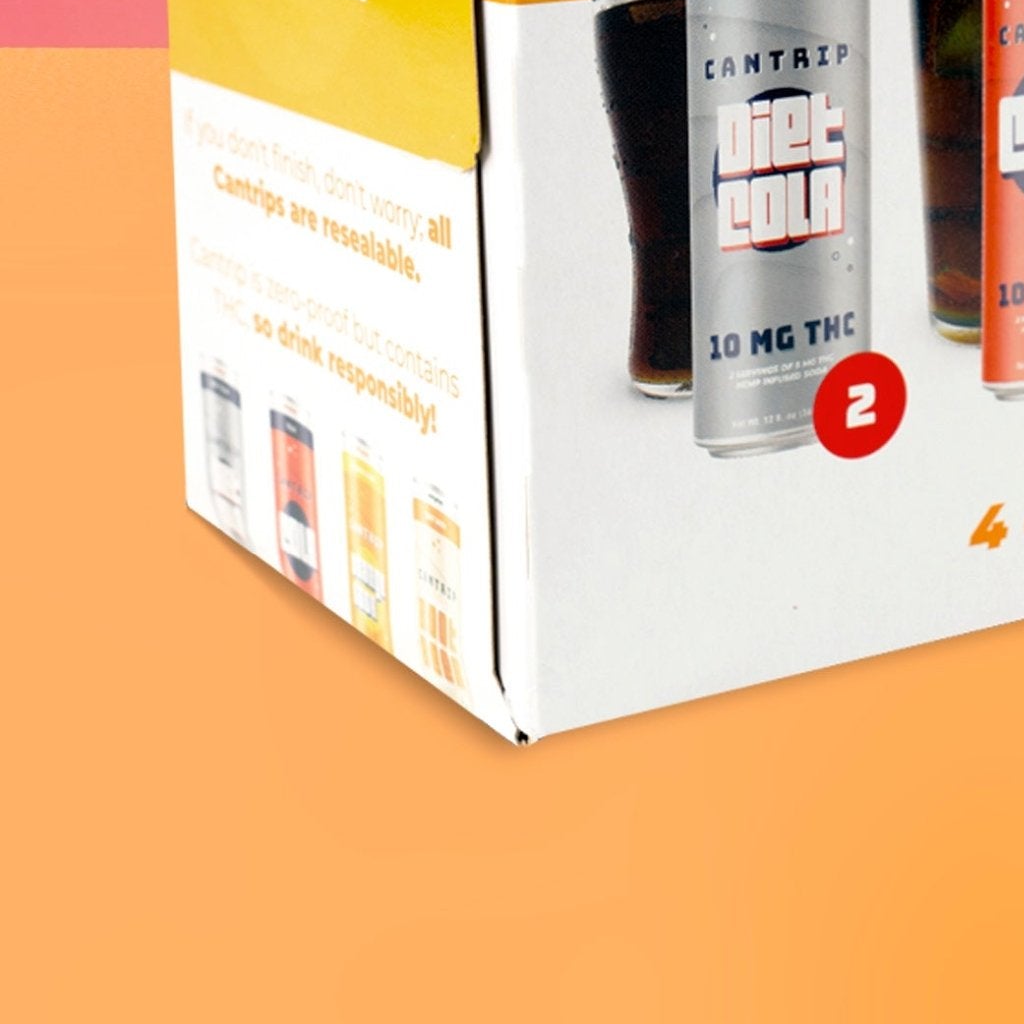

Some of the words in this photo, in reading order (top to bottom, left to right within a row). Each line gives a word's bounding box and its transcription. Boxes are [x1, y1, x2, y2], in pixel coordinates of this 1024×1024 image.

[704, 43, 849, 80] CANTRIP
[213, 164, 285, 218] Cantrips
[290, 201, 317, 232] are
[322, 215, 421, 284] resealable.
[427, 214, 452, 250] all
[717, 165, 845, 252] COLA
[709, 332, 741, 361] 10
[750, 324, 795, 356] MG
[804, 311, 855, 346] THC
[252, 312, 273, 340] so
[277, 321, 324, 368] drink
[327, 351, 438, 436] responsibly!
[385, 337, 461, 400] contains
[845, 382, 877, 430] 2
[968, 503, 1008, 549] 4
